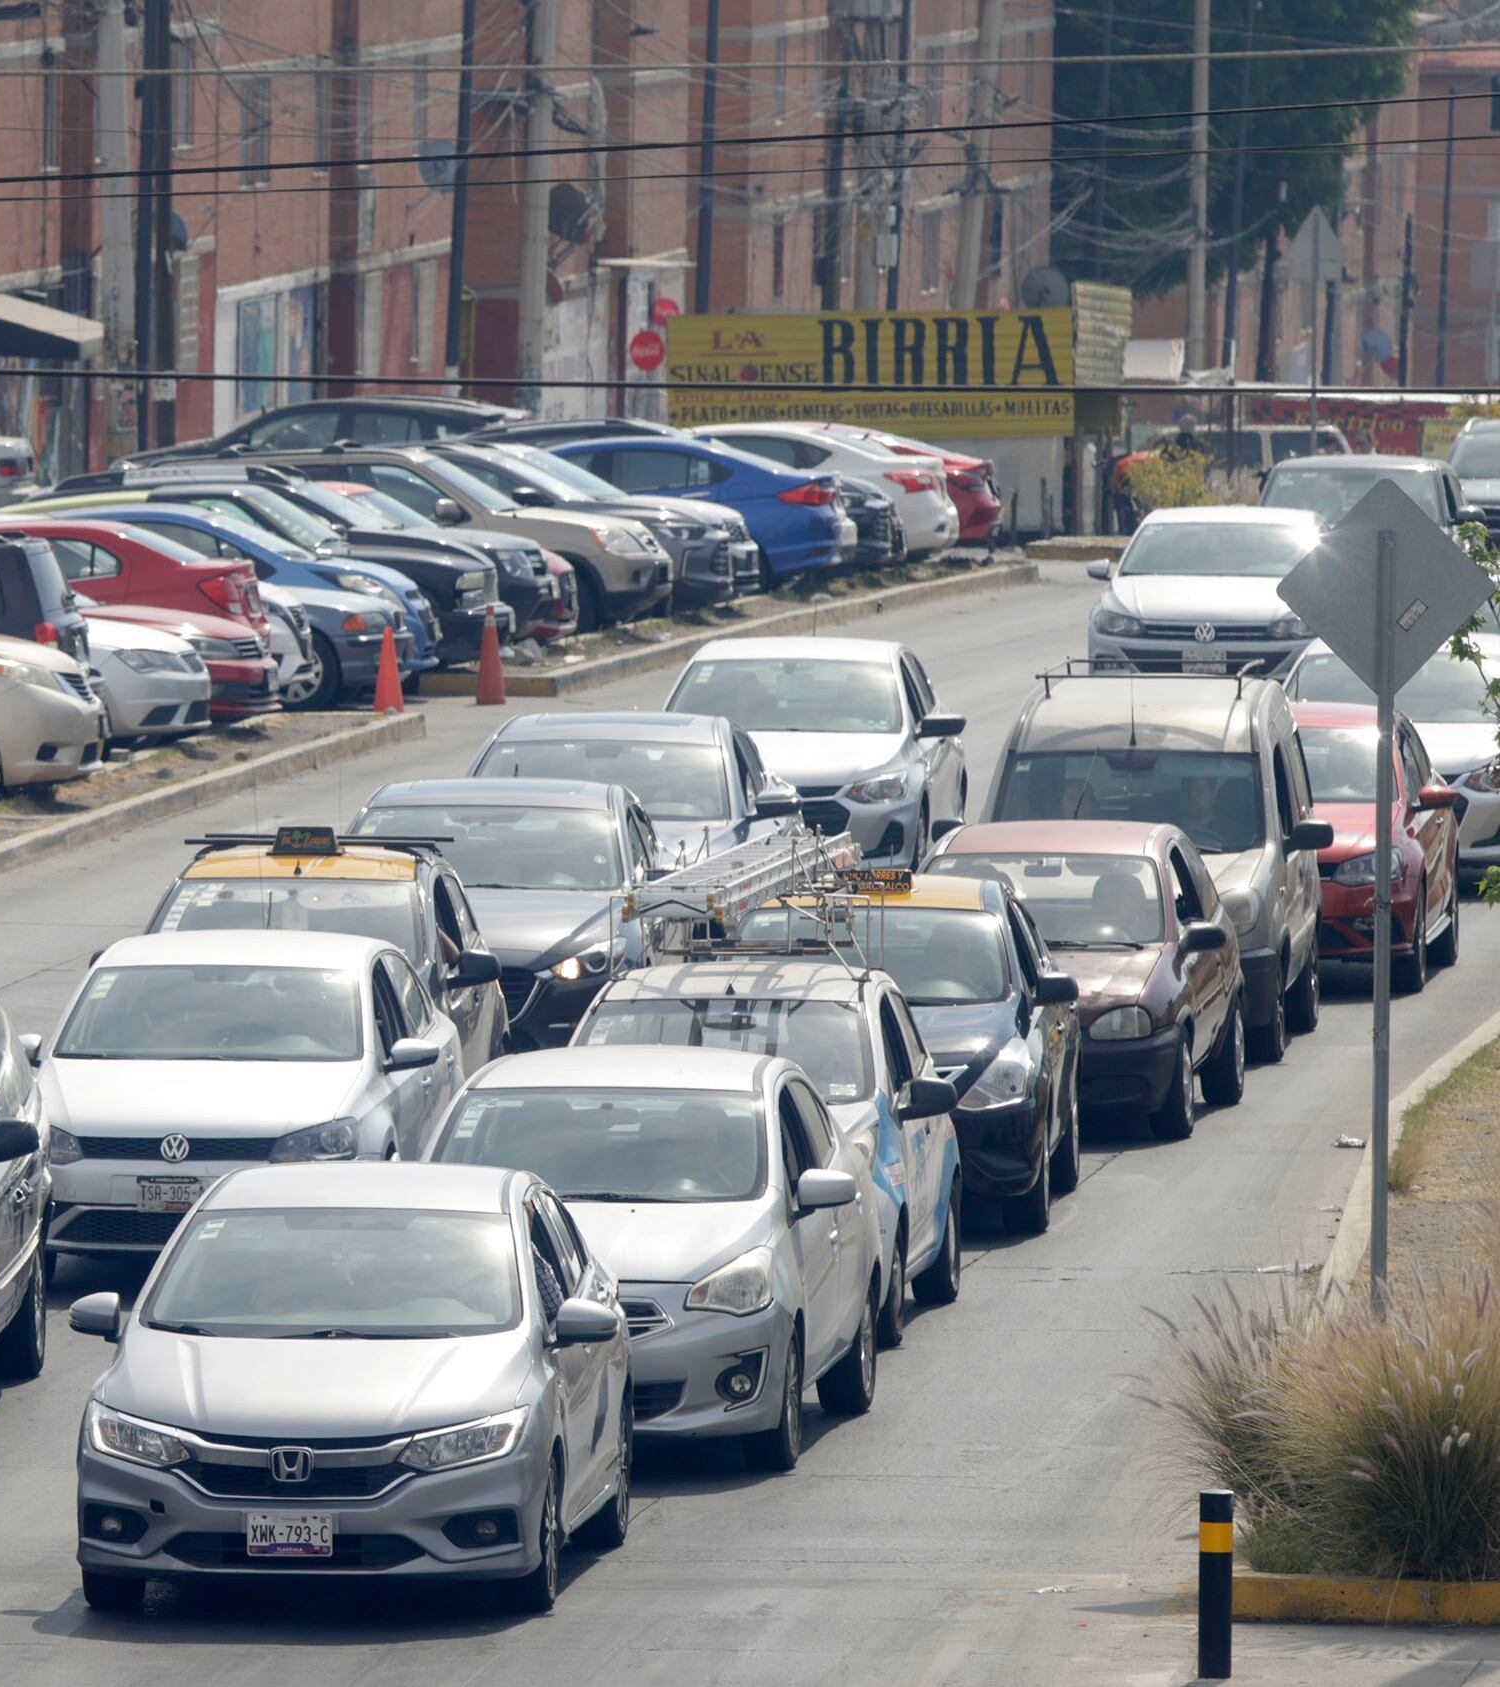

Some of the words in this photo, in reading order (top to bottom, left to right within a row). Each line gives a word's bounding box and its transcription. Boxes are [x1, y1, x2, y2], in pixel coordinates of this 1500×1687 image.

[711, 330, 764, 351] LA
[818, 314, 1061, 392] BIRRIA
[786, 402, 843, 419] CEMITAS
[909, 401, 994, 417] QUESADILLAS
[250, 1524, 329, 1544] XWK-793-C
